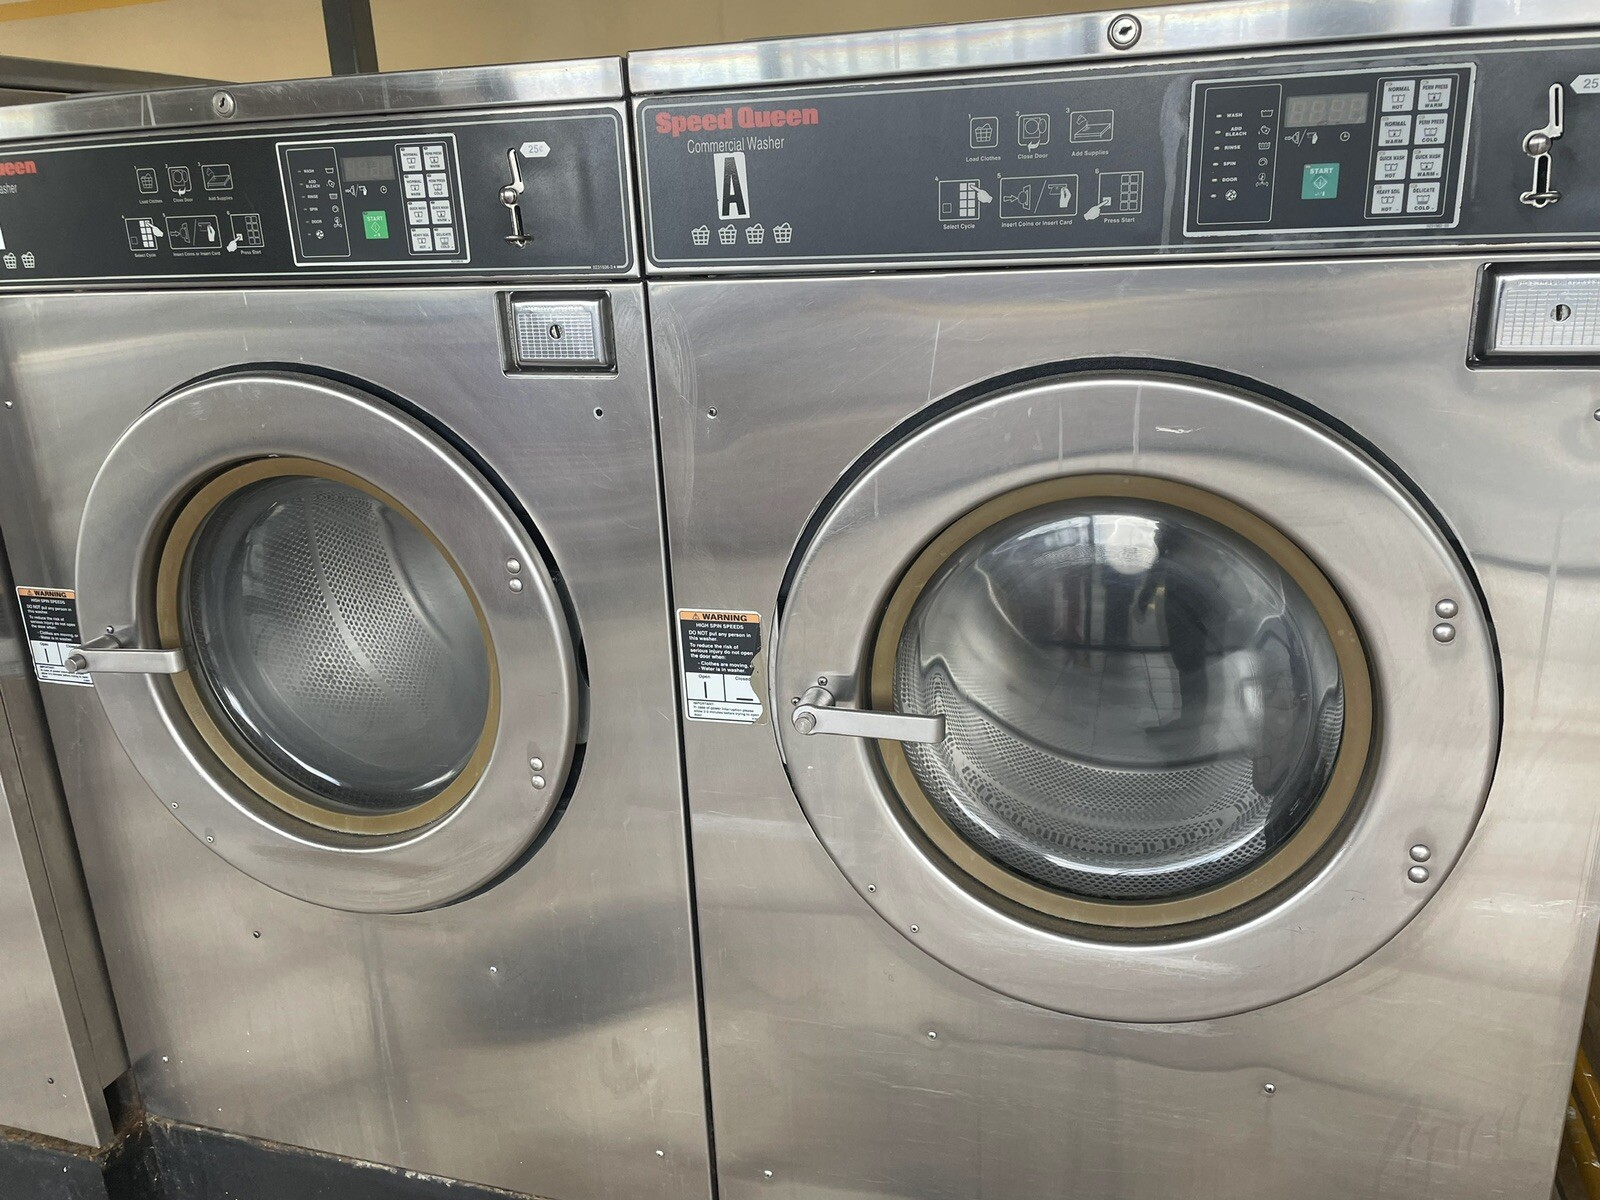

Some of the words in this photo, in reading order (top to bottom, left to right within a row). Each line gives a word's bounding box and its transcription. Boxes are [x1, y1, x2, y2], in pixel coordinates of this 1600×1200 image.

[655, 108, 733, 138] Speed
[738, 106, 819, 128] Queen
[687, 138, 744, 154] Commercial
[746, 136, 784, 150] Washer
[1084, 149, 1109, 157] Supplies
[722, 157, 746, 216] A
